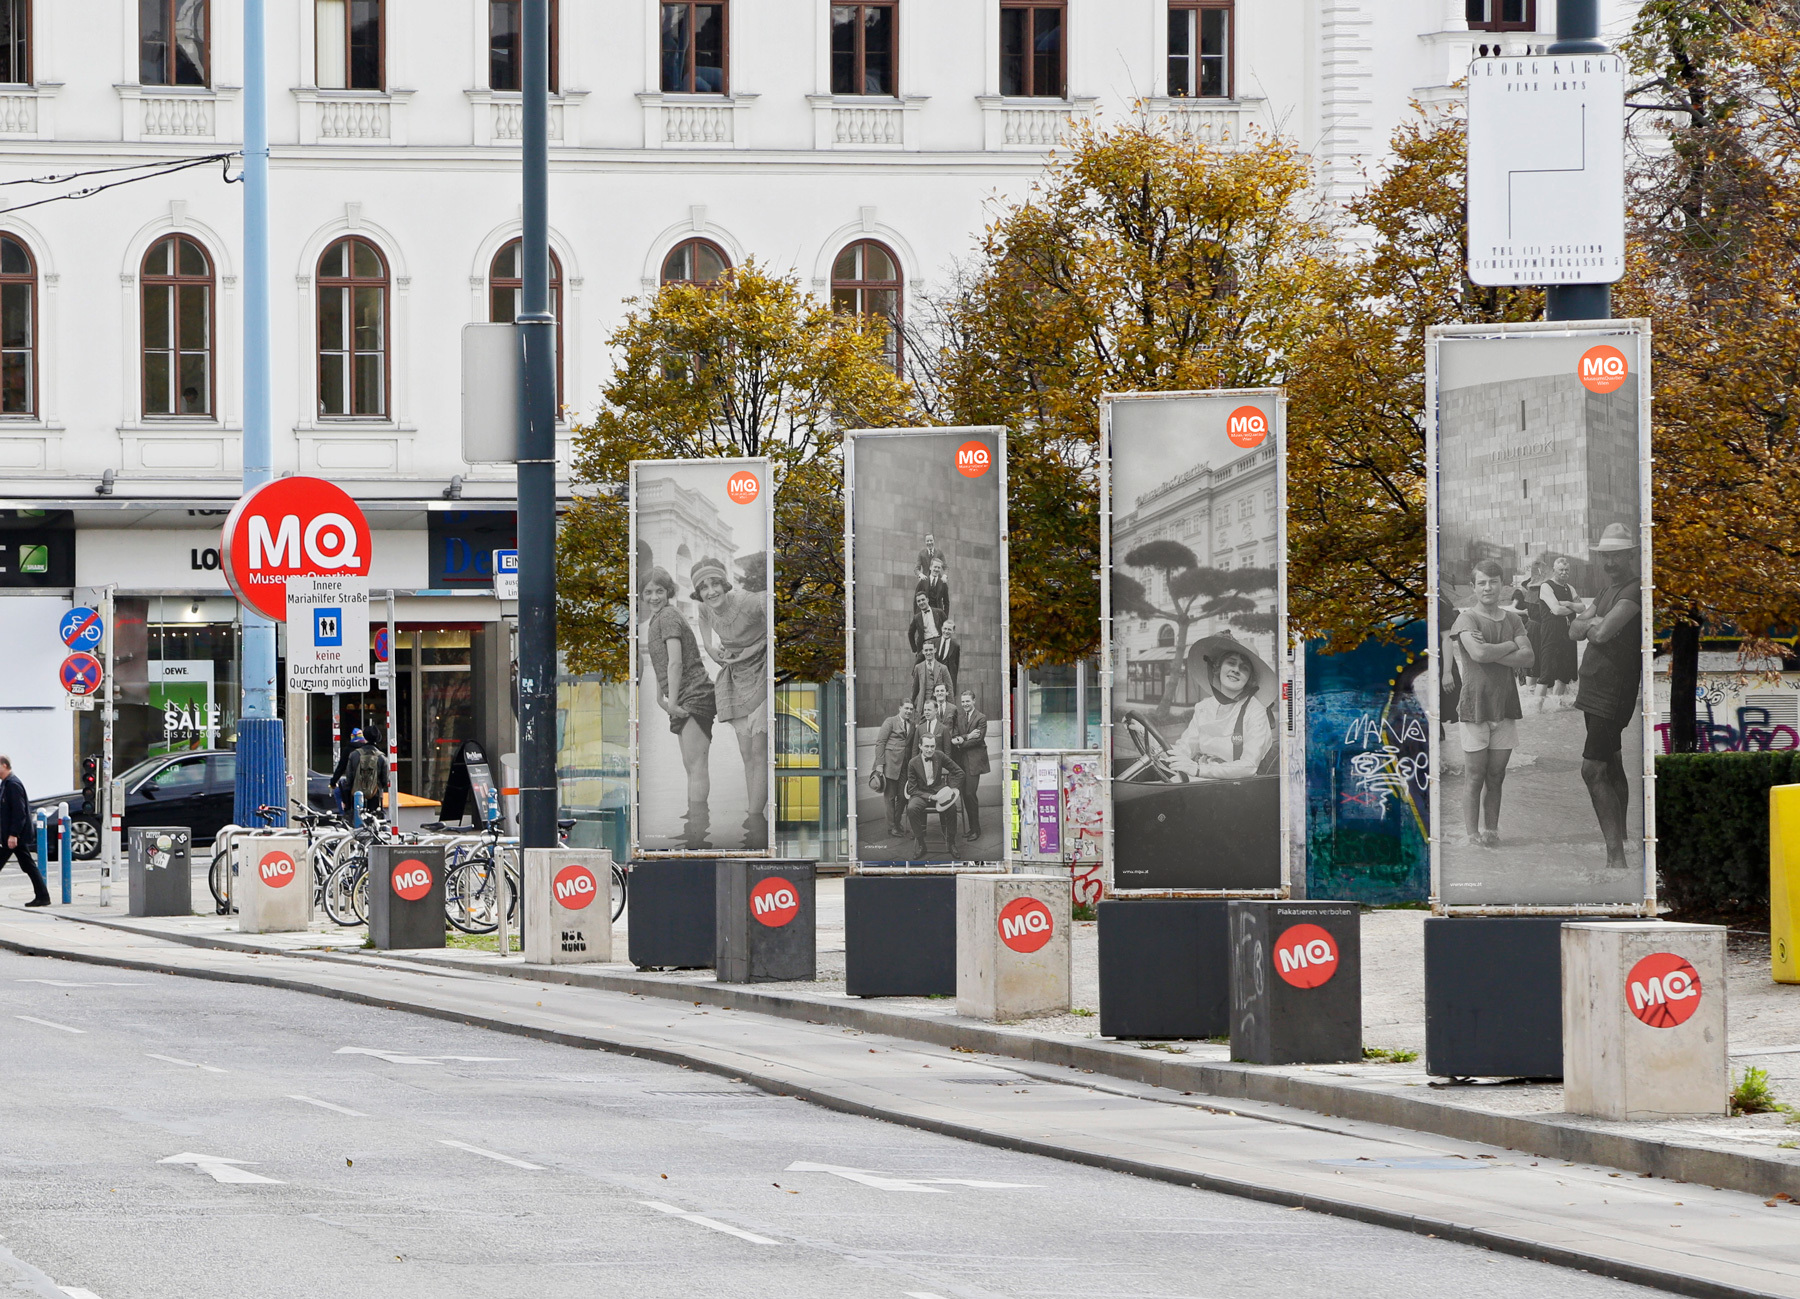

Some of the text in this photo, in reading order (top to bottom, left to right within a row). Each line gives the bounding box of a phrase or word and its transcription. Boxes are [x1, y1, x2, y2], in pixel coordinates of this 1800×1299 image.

[1472, 59, 1621, 77] GEORG KARGL
[1507, 80, 1587, 92] FINE ARTS
[1492, 245, 1602, 256] TEL (1) 5854199
[1475, 256, 1619, 269] SCHLEIFMÜHLGASSE 5
[1514, 270, 1582, 281] WIEN 1040
[1583, 356, 1625, 376] MQ
[1230, 415, 1265, 433] MQ
[958, 449, 989, 465] MQ
[1491, 437, 1554, 462] mumok
[730, 478, 758, 493] MQ
[248, 512, 361, 570] MQ
[312, 580, 342, 590] Innere
[288, 593, 368, 604] Mariahilfer Straße
[316, 650, 341, 660] keine
[293, 664, 343, 675] Durchfahrt
[346, 664, 364, 674] und
[332, 677, 368, 689] möglich
[163, 702, 221, 712] SEASON
[163, 711, 221, 731] SALE
[261, 859, 293, 879] MQ
[395, 869, 430, 891] MQ
[556, 875, 594, 900] MQ
[754, 889, 797, 915] MQ
[1319, 907, 1352, 915] verboten
[1002, 910, 1050, 939] MQ
[1279, 939, 1335, 973] MQ
[1631, 970, 1697, 1010] MQ
